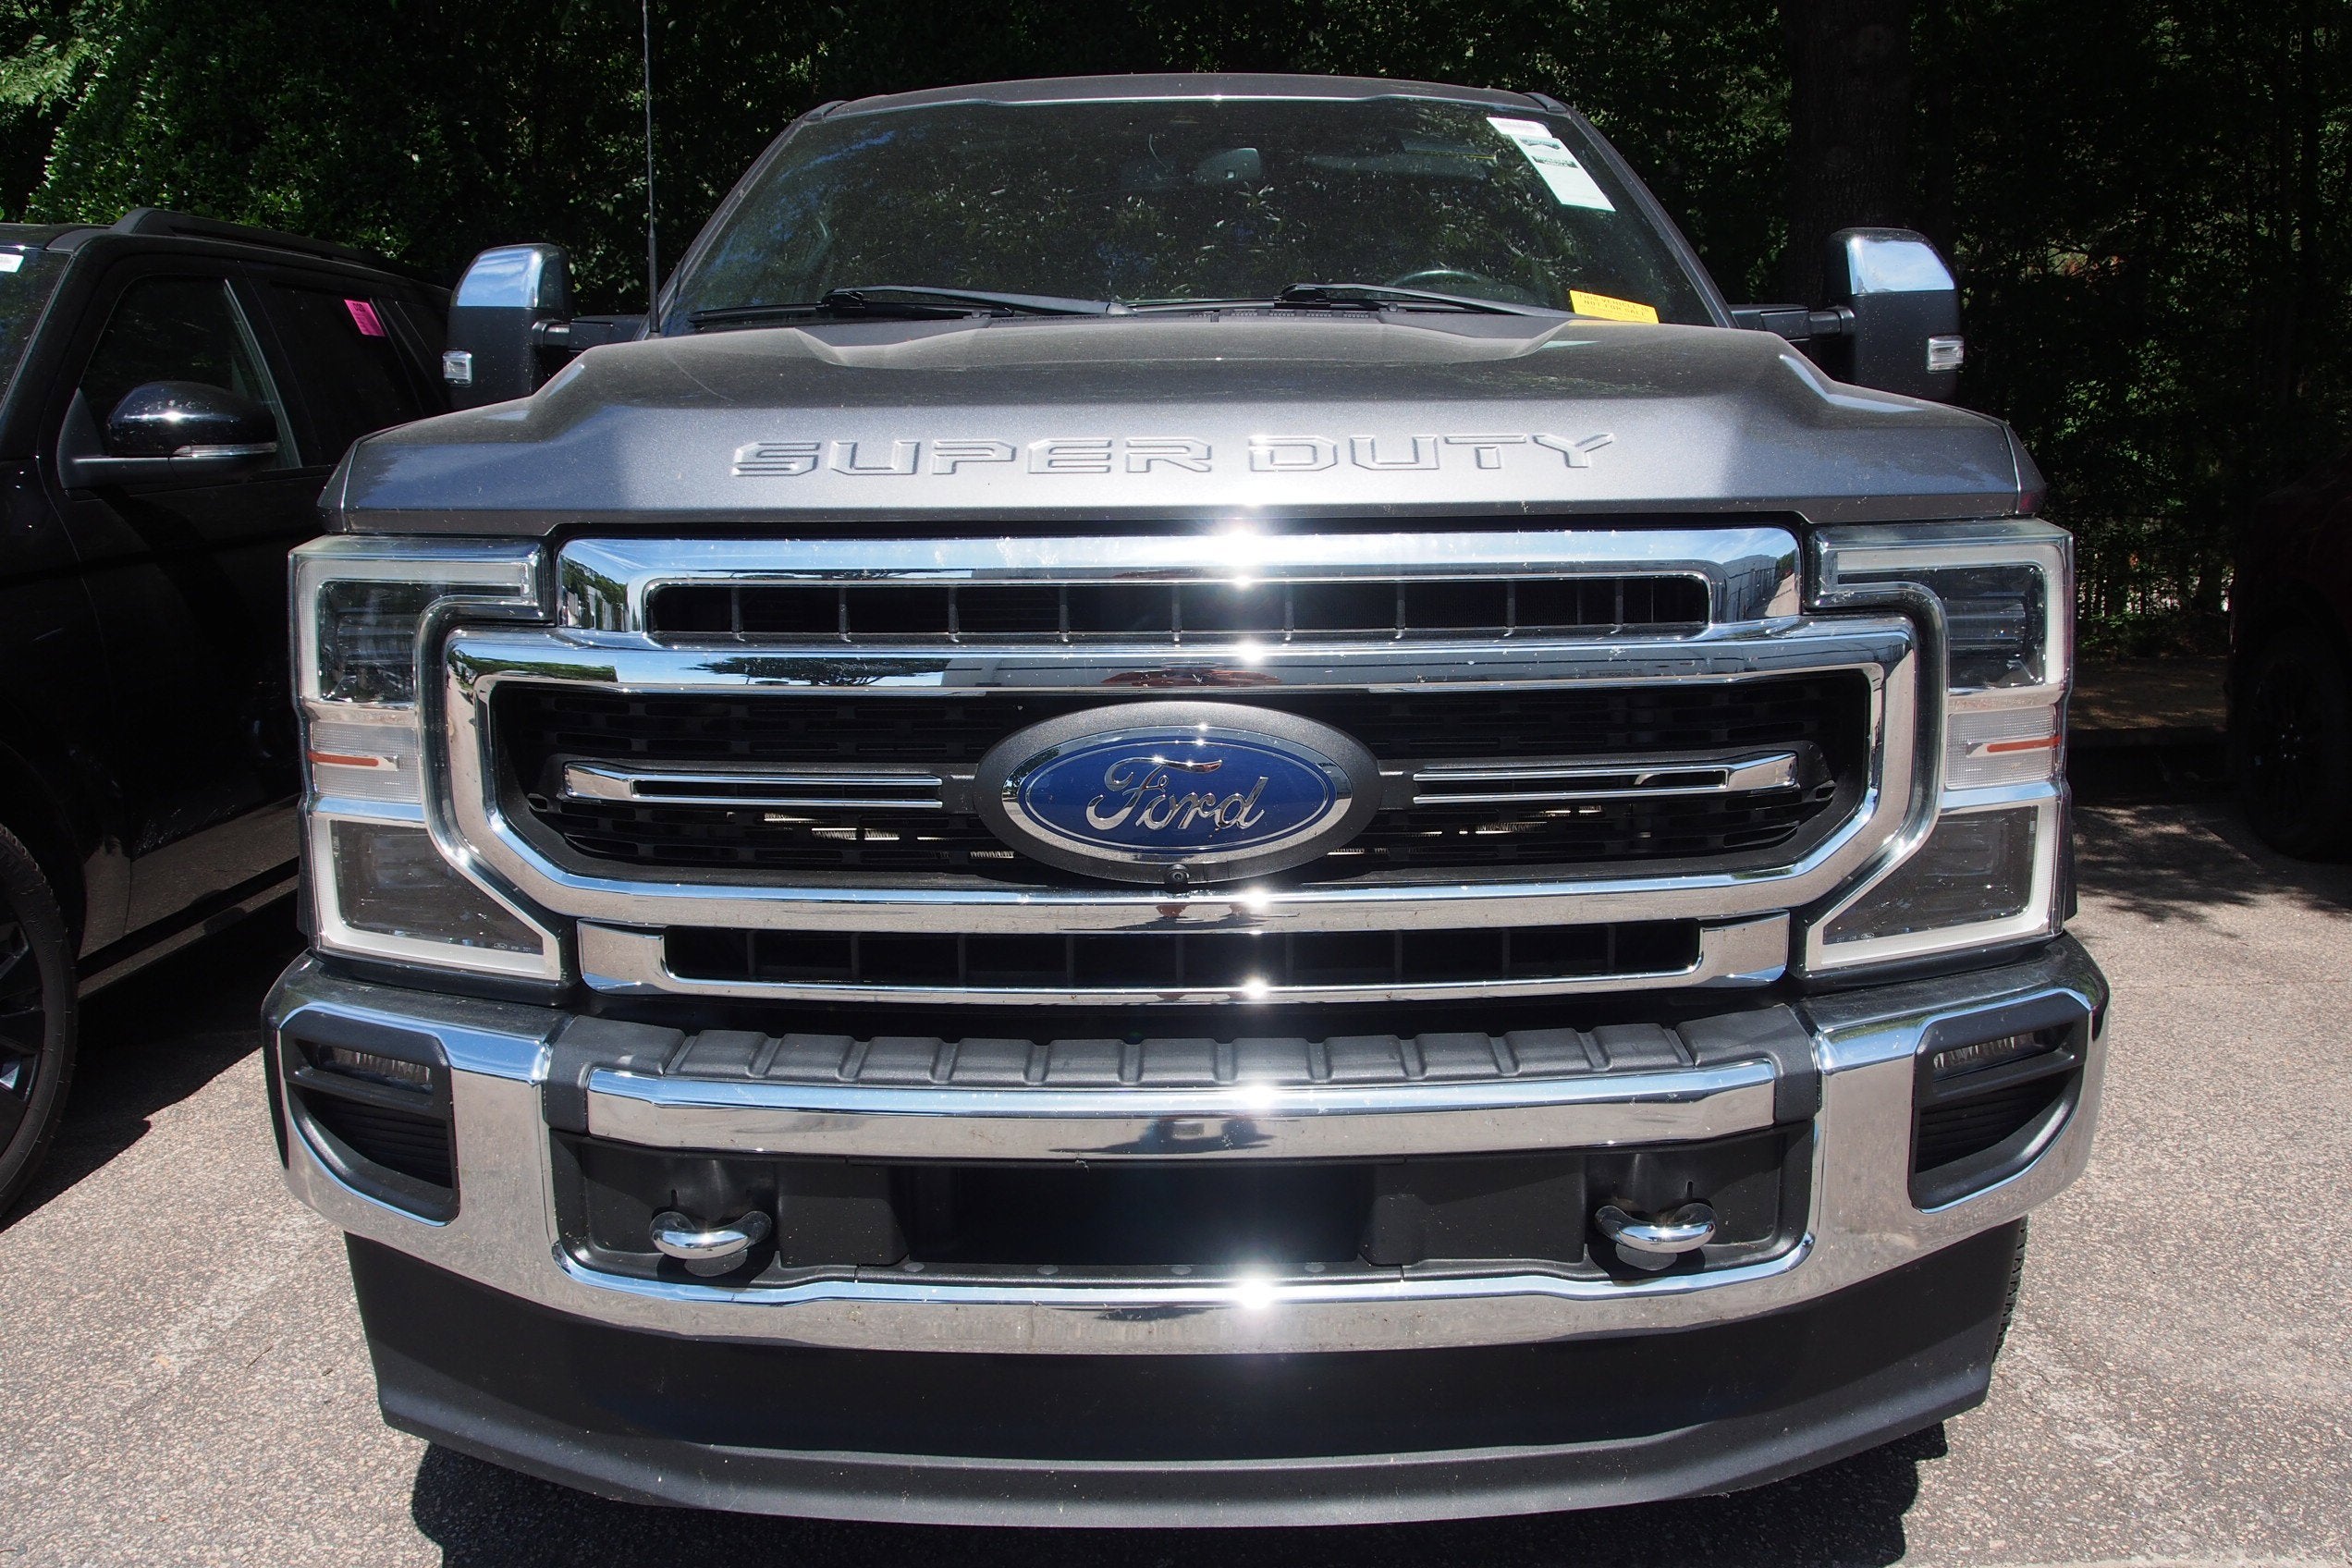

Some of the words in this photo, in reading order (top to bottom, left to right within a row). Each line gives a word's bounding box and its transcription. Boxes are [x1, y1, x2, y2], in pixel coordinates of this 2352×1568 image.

[731, 437, 1213, 477] SUPER
[1249, 432, 1615, 472] DUTY
[1085, 756, 1269, 831] Ford
